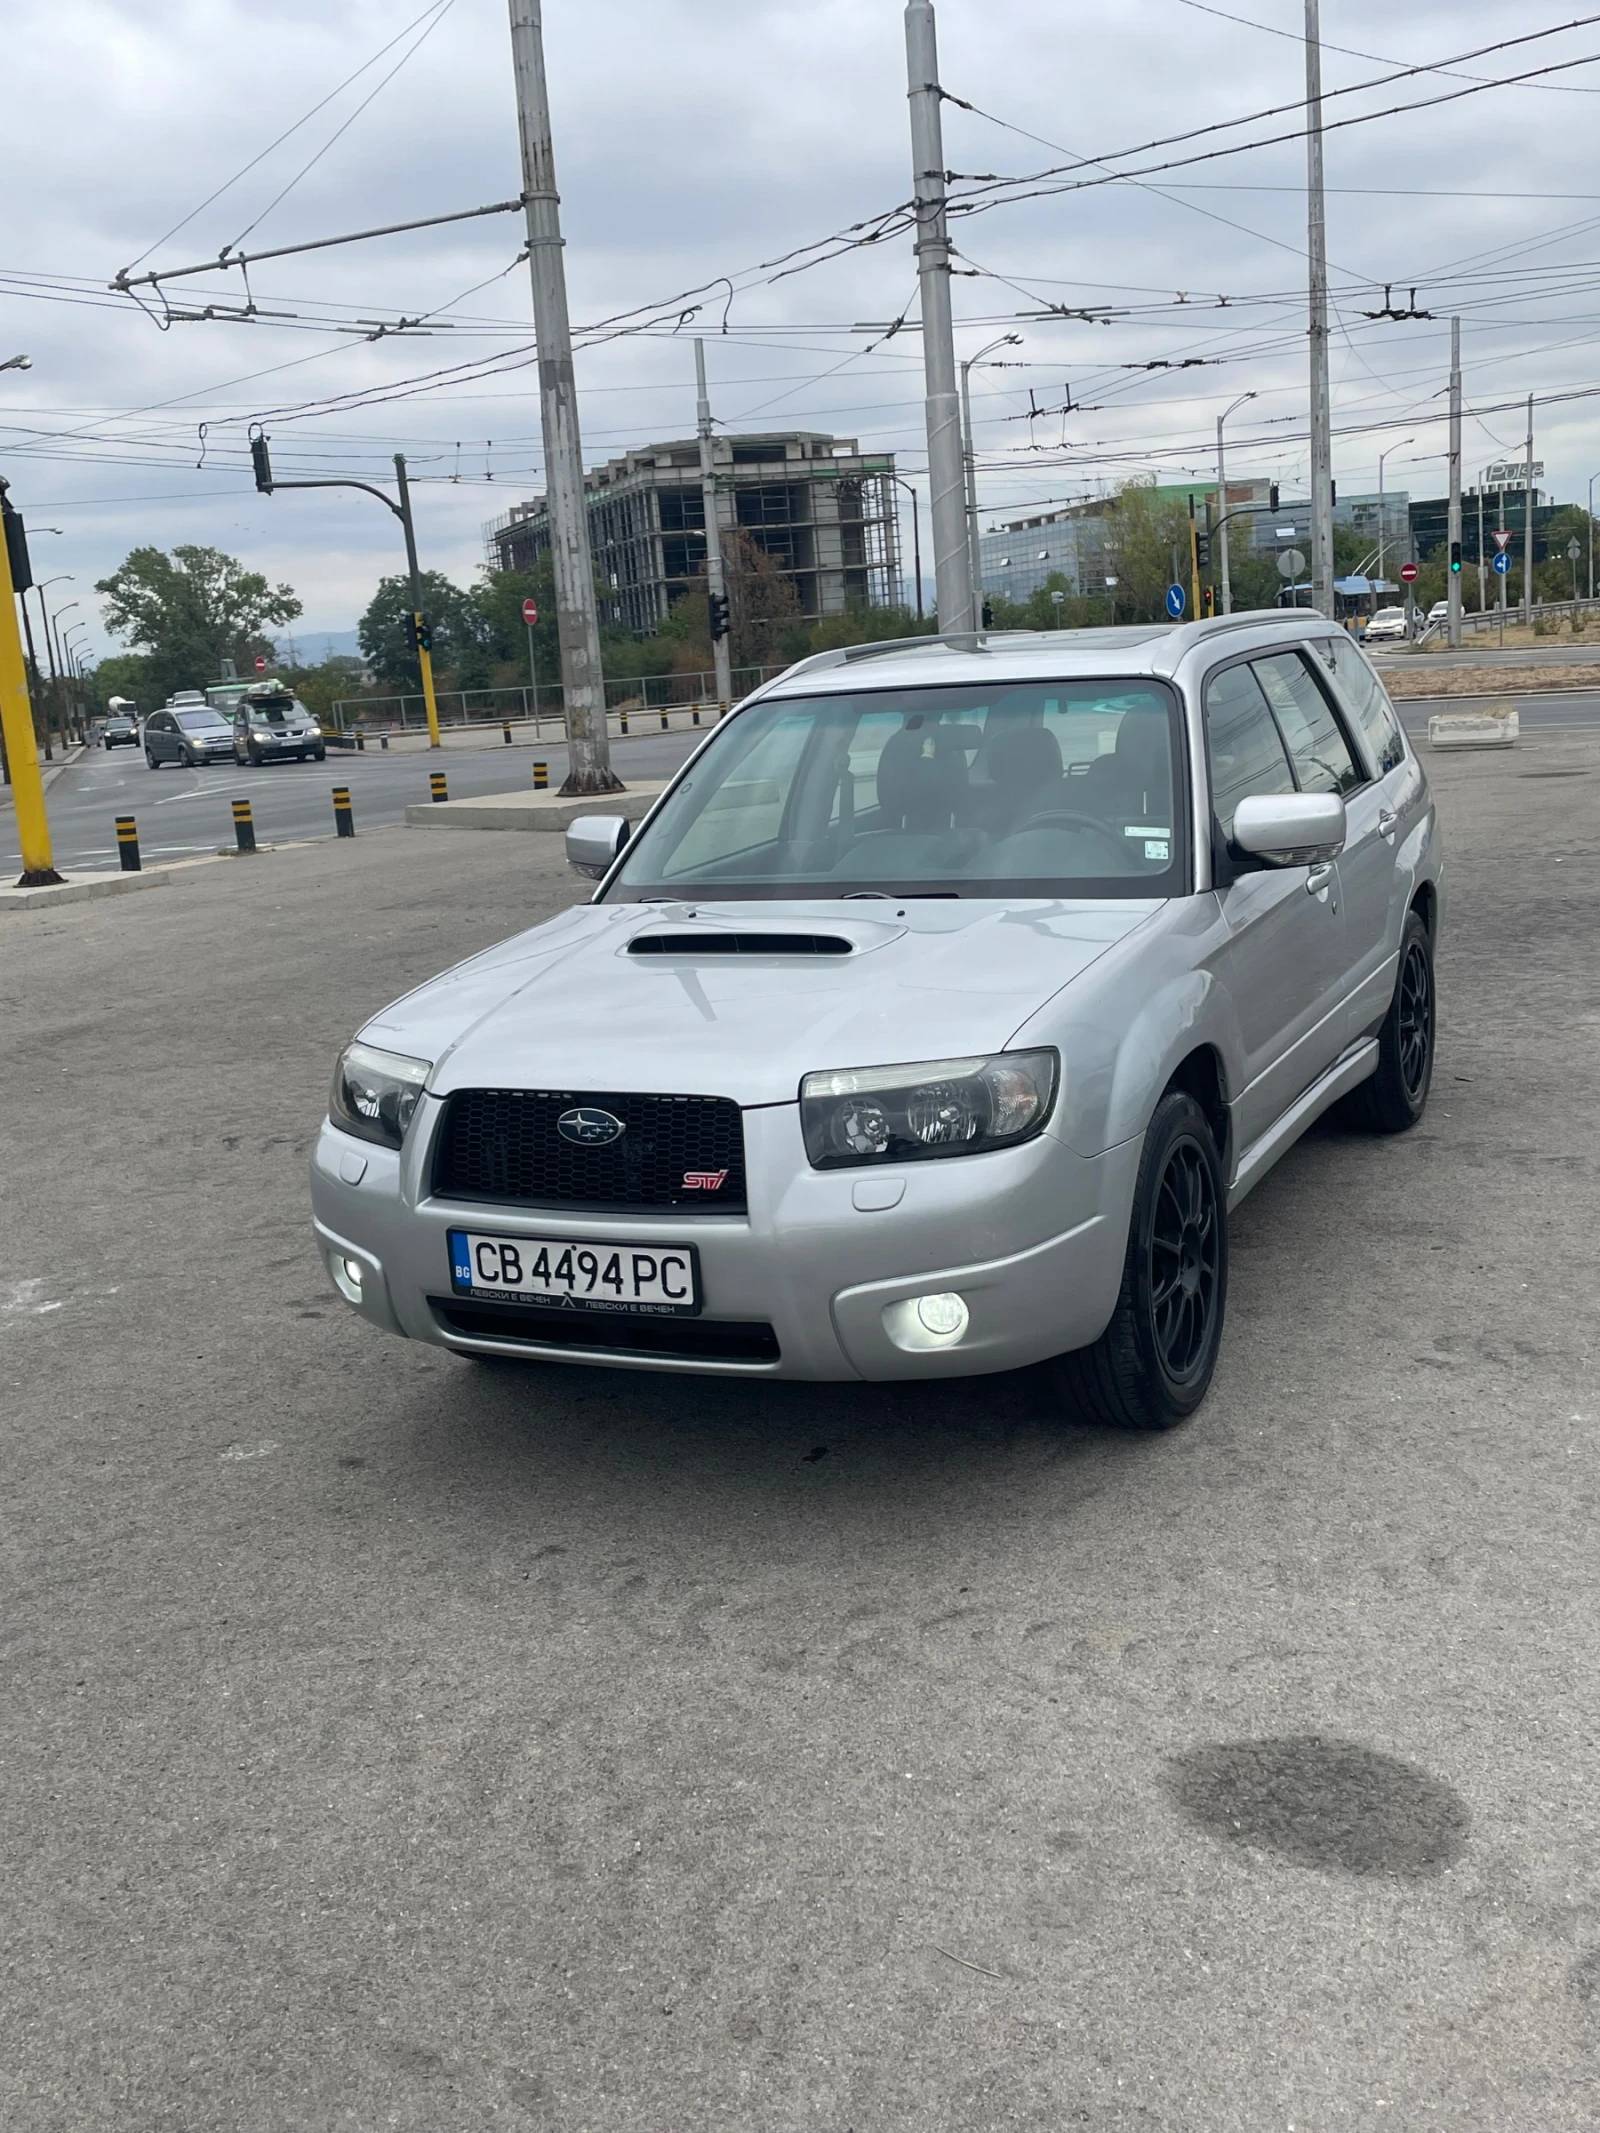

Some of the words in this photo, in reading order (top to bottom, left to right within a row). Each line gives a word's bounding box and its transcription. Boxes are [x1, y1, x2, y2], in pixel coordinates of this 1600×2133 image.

[1488, 464, 1544, 482] Pulse
[455, 1266, 470, 1279] BG
[470, 1289, 510, 1300] ЛЕВСКИ
[519, 1294, 551, 1305] ВЕЧЕН
[585, 1300, 628, 1312] ЛЕВСКИ
[639, 1304, 675, 1314] ВЕЧЕН
